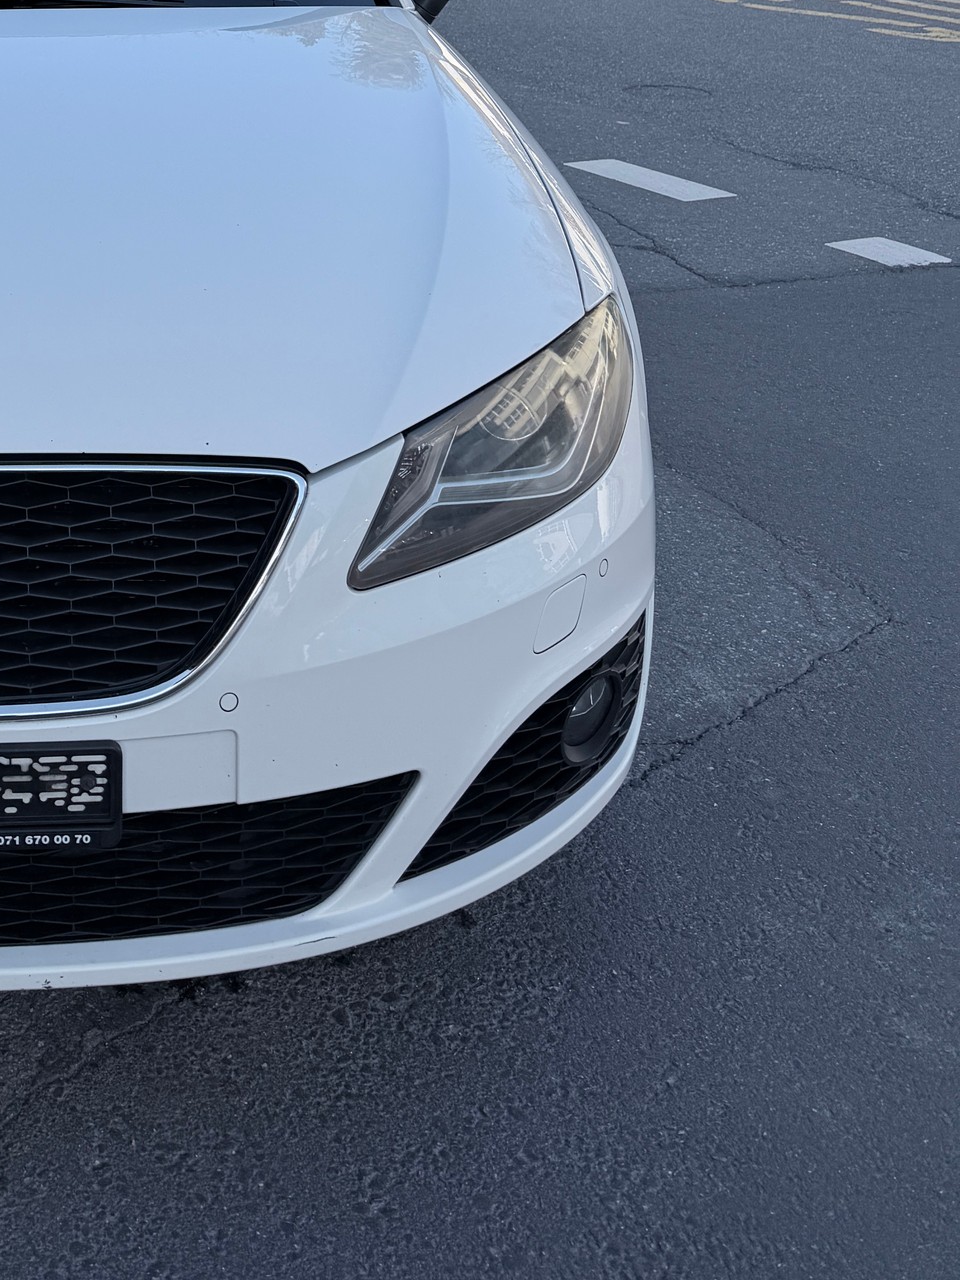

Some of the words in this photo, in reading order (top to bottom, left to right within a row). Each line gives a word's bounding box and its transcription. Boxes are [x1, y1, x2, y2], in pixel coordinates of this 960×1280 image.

[24, 835, 50, 845] 670
[53, 834, 71, 845] 00
[74, 834, 91, 844] 70
